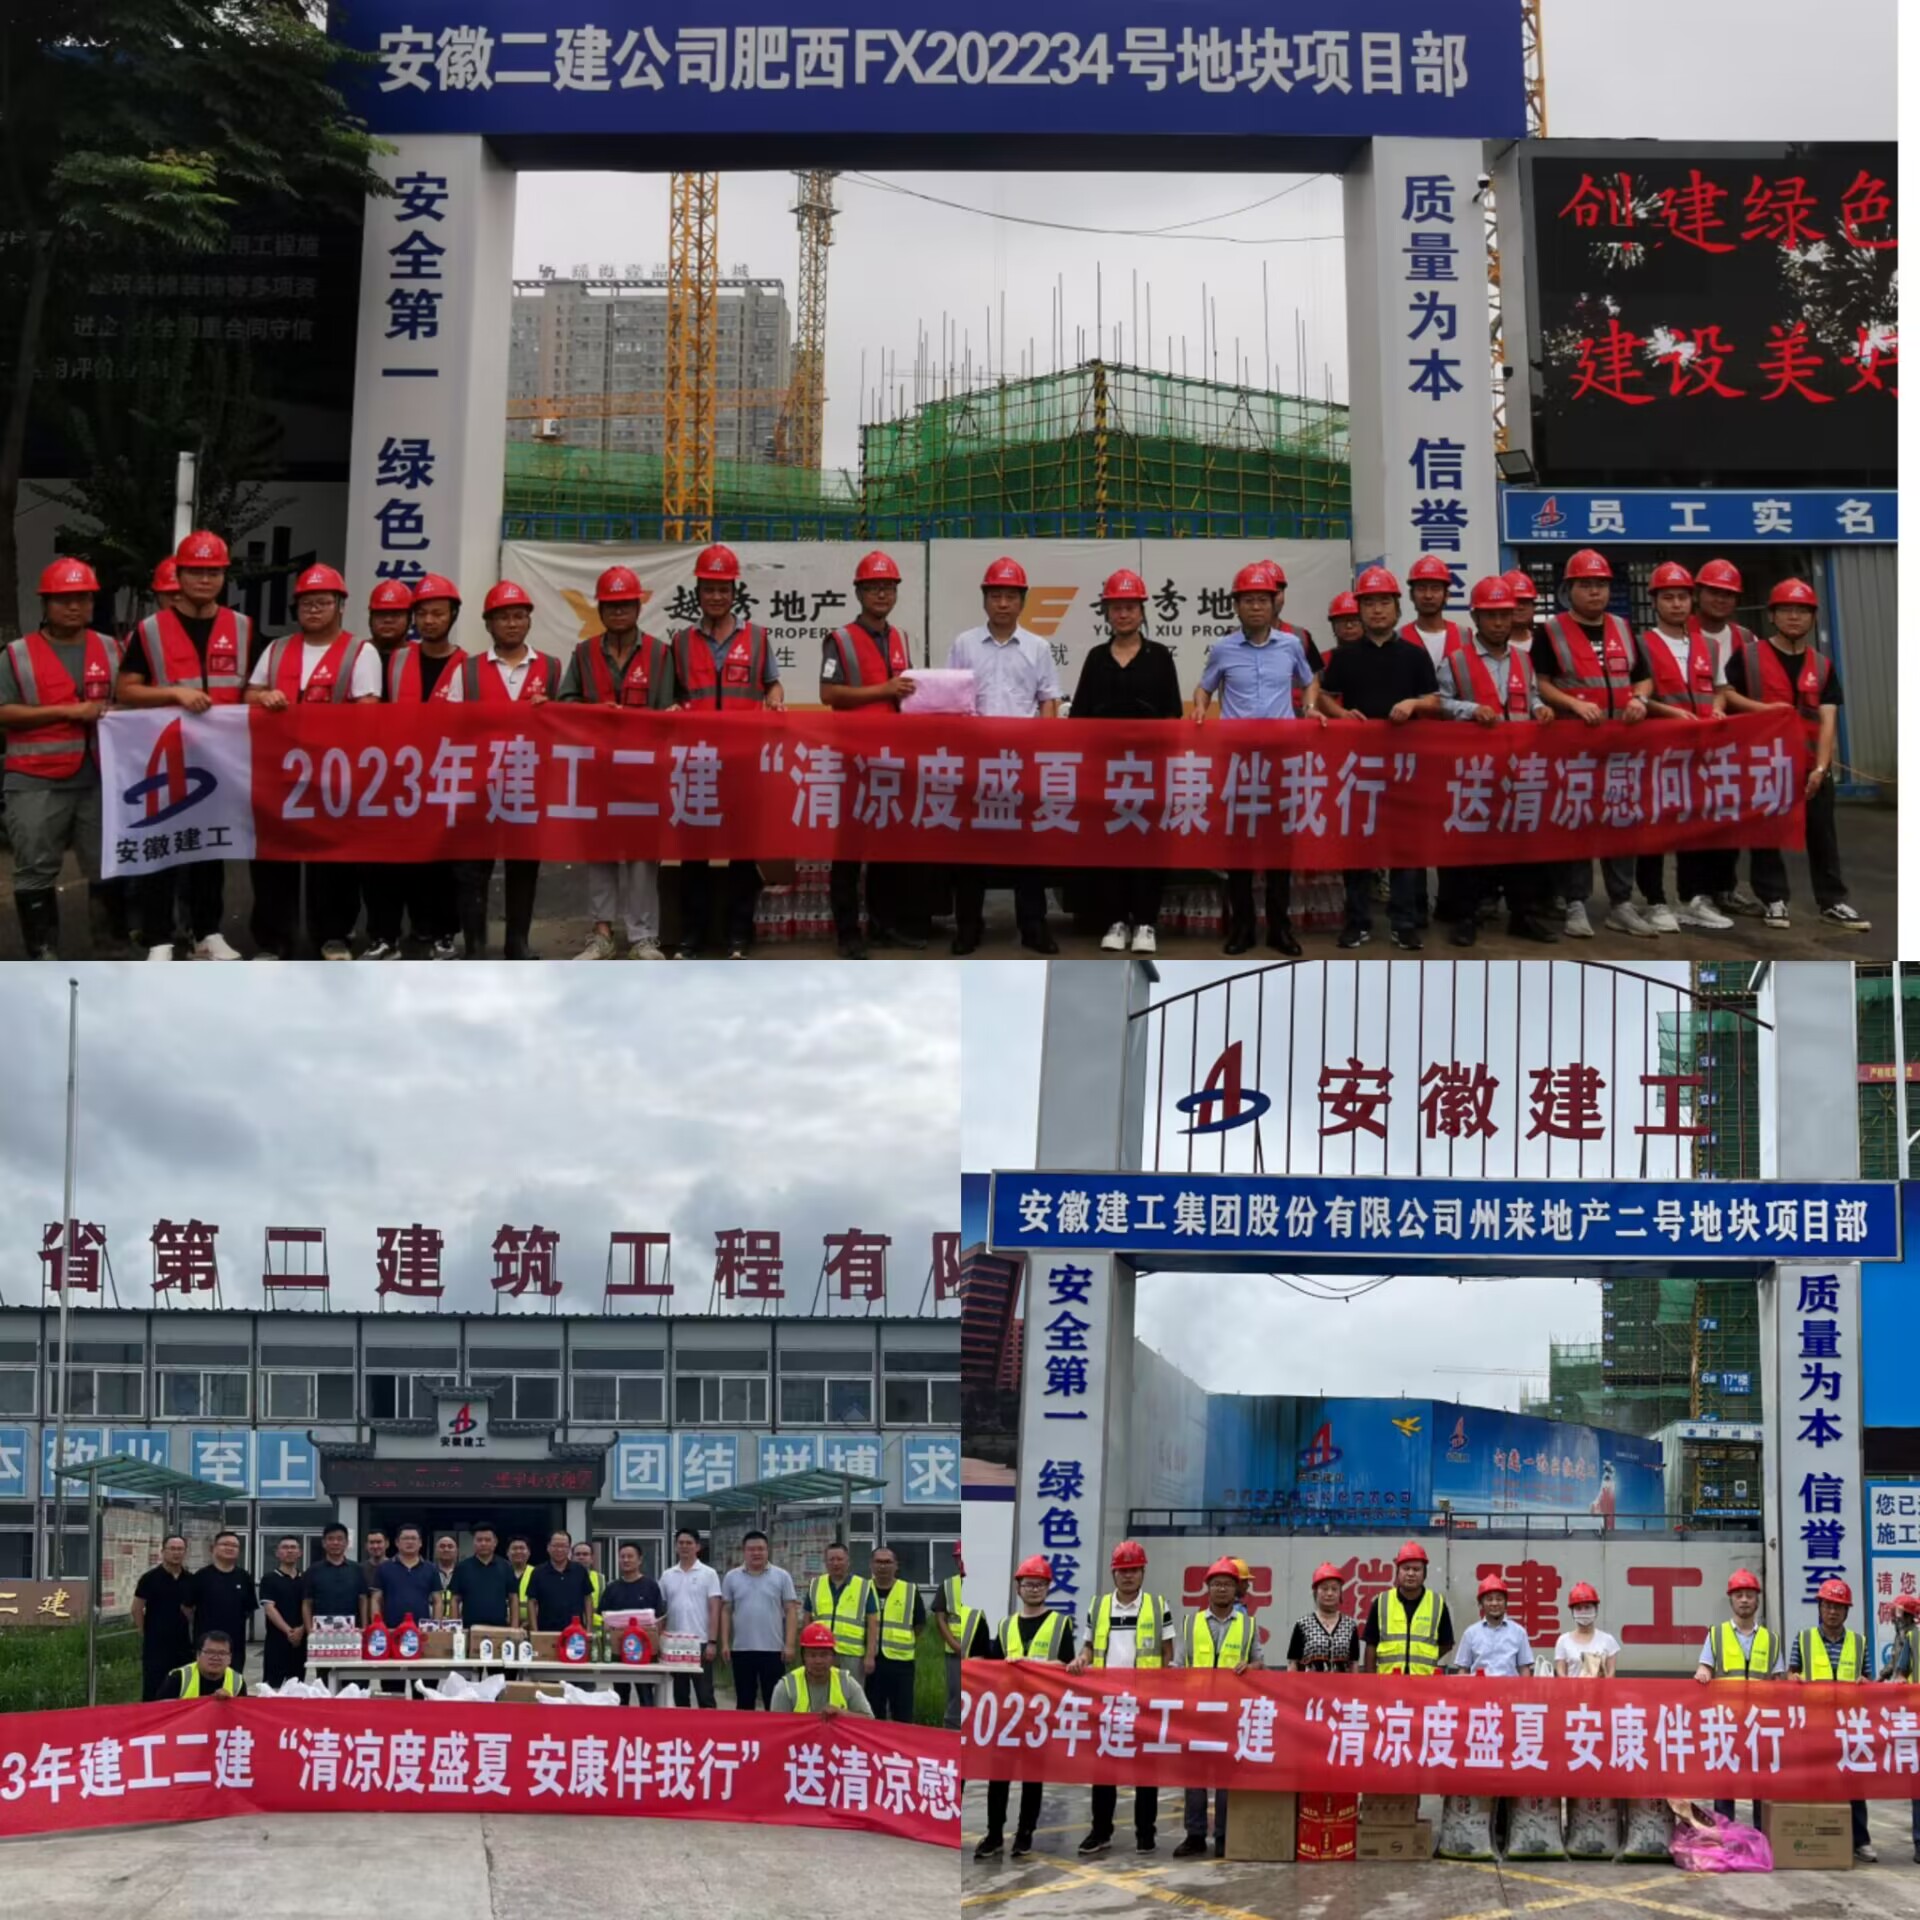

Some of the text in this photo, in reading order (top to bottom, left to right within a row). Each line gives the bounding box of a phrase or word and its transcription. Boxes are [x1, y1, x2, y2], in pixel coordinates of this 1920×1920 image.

[379, 23, 1468, 97] 安徽二建公司肥西FX202234号地块项目部
[1558, 169, 1898, 254] 创建绿色
[382, 170, 449, 378] 安全第一
[1401, 174, 1464, 401] 质量为本
[1588, 500, 1875, 534] 员工实名
[1089, 578, 1235, 622] 秀地
[1155, 624, 1183, 637] XIU
[281, 734, 1796, 838] 2023年建工二建 “清凉度盛夏 安康伴我行” 送清凉慰问活动
[116, 825, 233, 864] 安徽建工
[1318, 1057, 1712, 1141] 安徽建工
[1018, 1189, 1868, 1243] 安徽建工集团股份有限公司州来地产二号地块项目部
[1044, 1263, 1093, 1421] 安全第一
[1796, 1274, 1843, 1448] 质量为本
[1876, 1493, 1920, 1517] 您已
[1877, 1523, 1920, 1545] 施工
[1, 1725, 255, 1803] 3年建工二建
[279, 1727, 512, 1795] “清凉度盛夏
[527, 1733, 760, 1801] 安康伴我行”
[1305, 1697, 1549, 1772] “清凉度盛夏
[1564, 1702, 1806, 1773] 安康伴我行”
